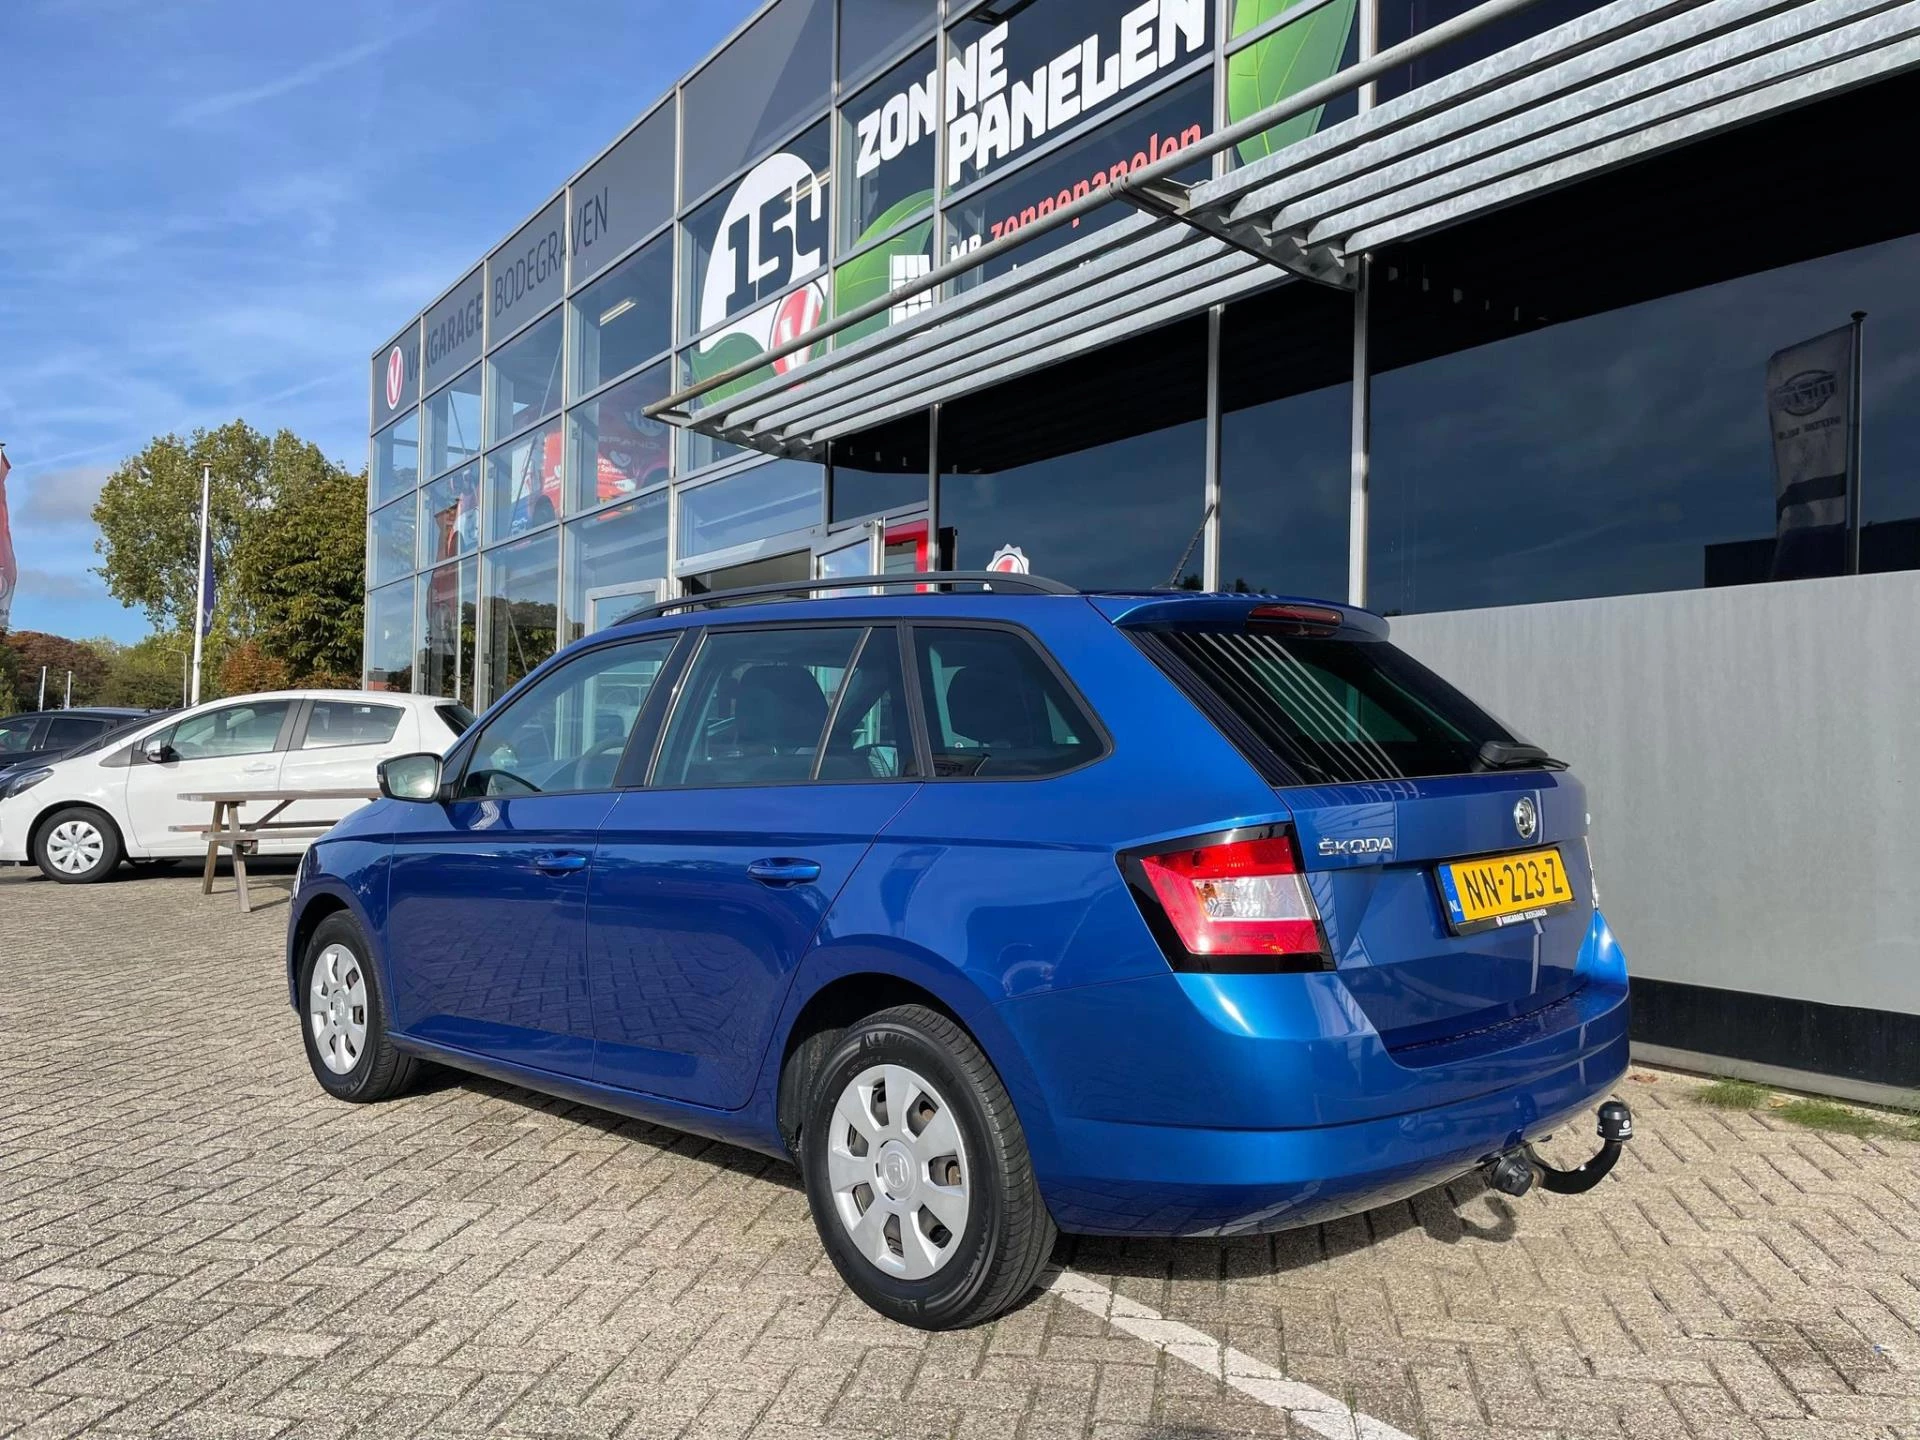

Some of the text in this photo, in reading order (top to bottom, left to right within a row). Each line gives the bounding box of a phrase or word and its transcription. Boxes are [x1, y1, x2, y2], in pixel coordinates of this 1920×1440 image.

[856, 21, 1008, 179] ZONNE
[947, 0, 1205, 185] PANELEN
[494, 187, 608, 318] BODEGRAVEN
[1318, 837, 1394, 856] ŠKODA
[1448, 858, 1562, 912] NL NN-223-Z
